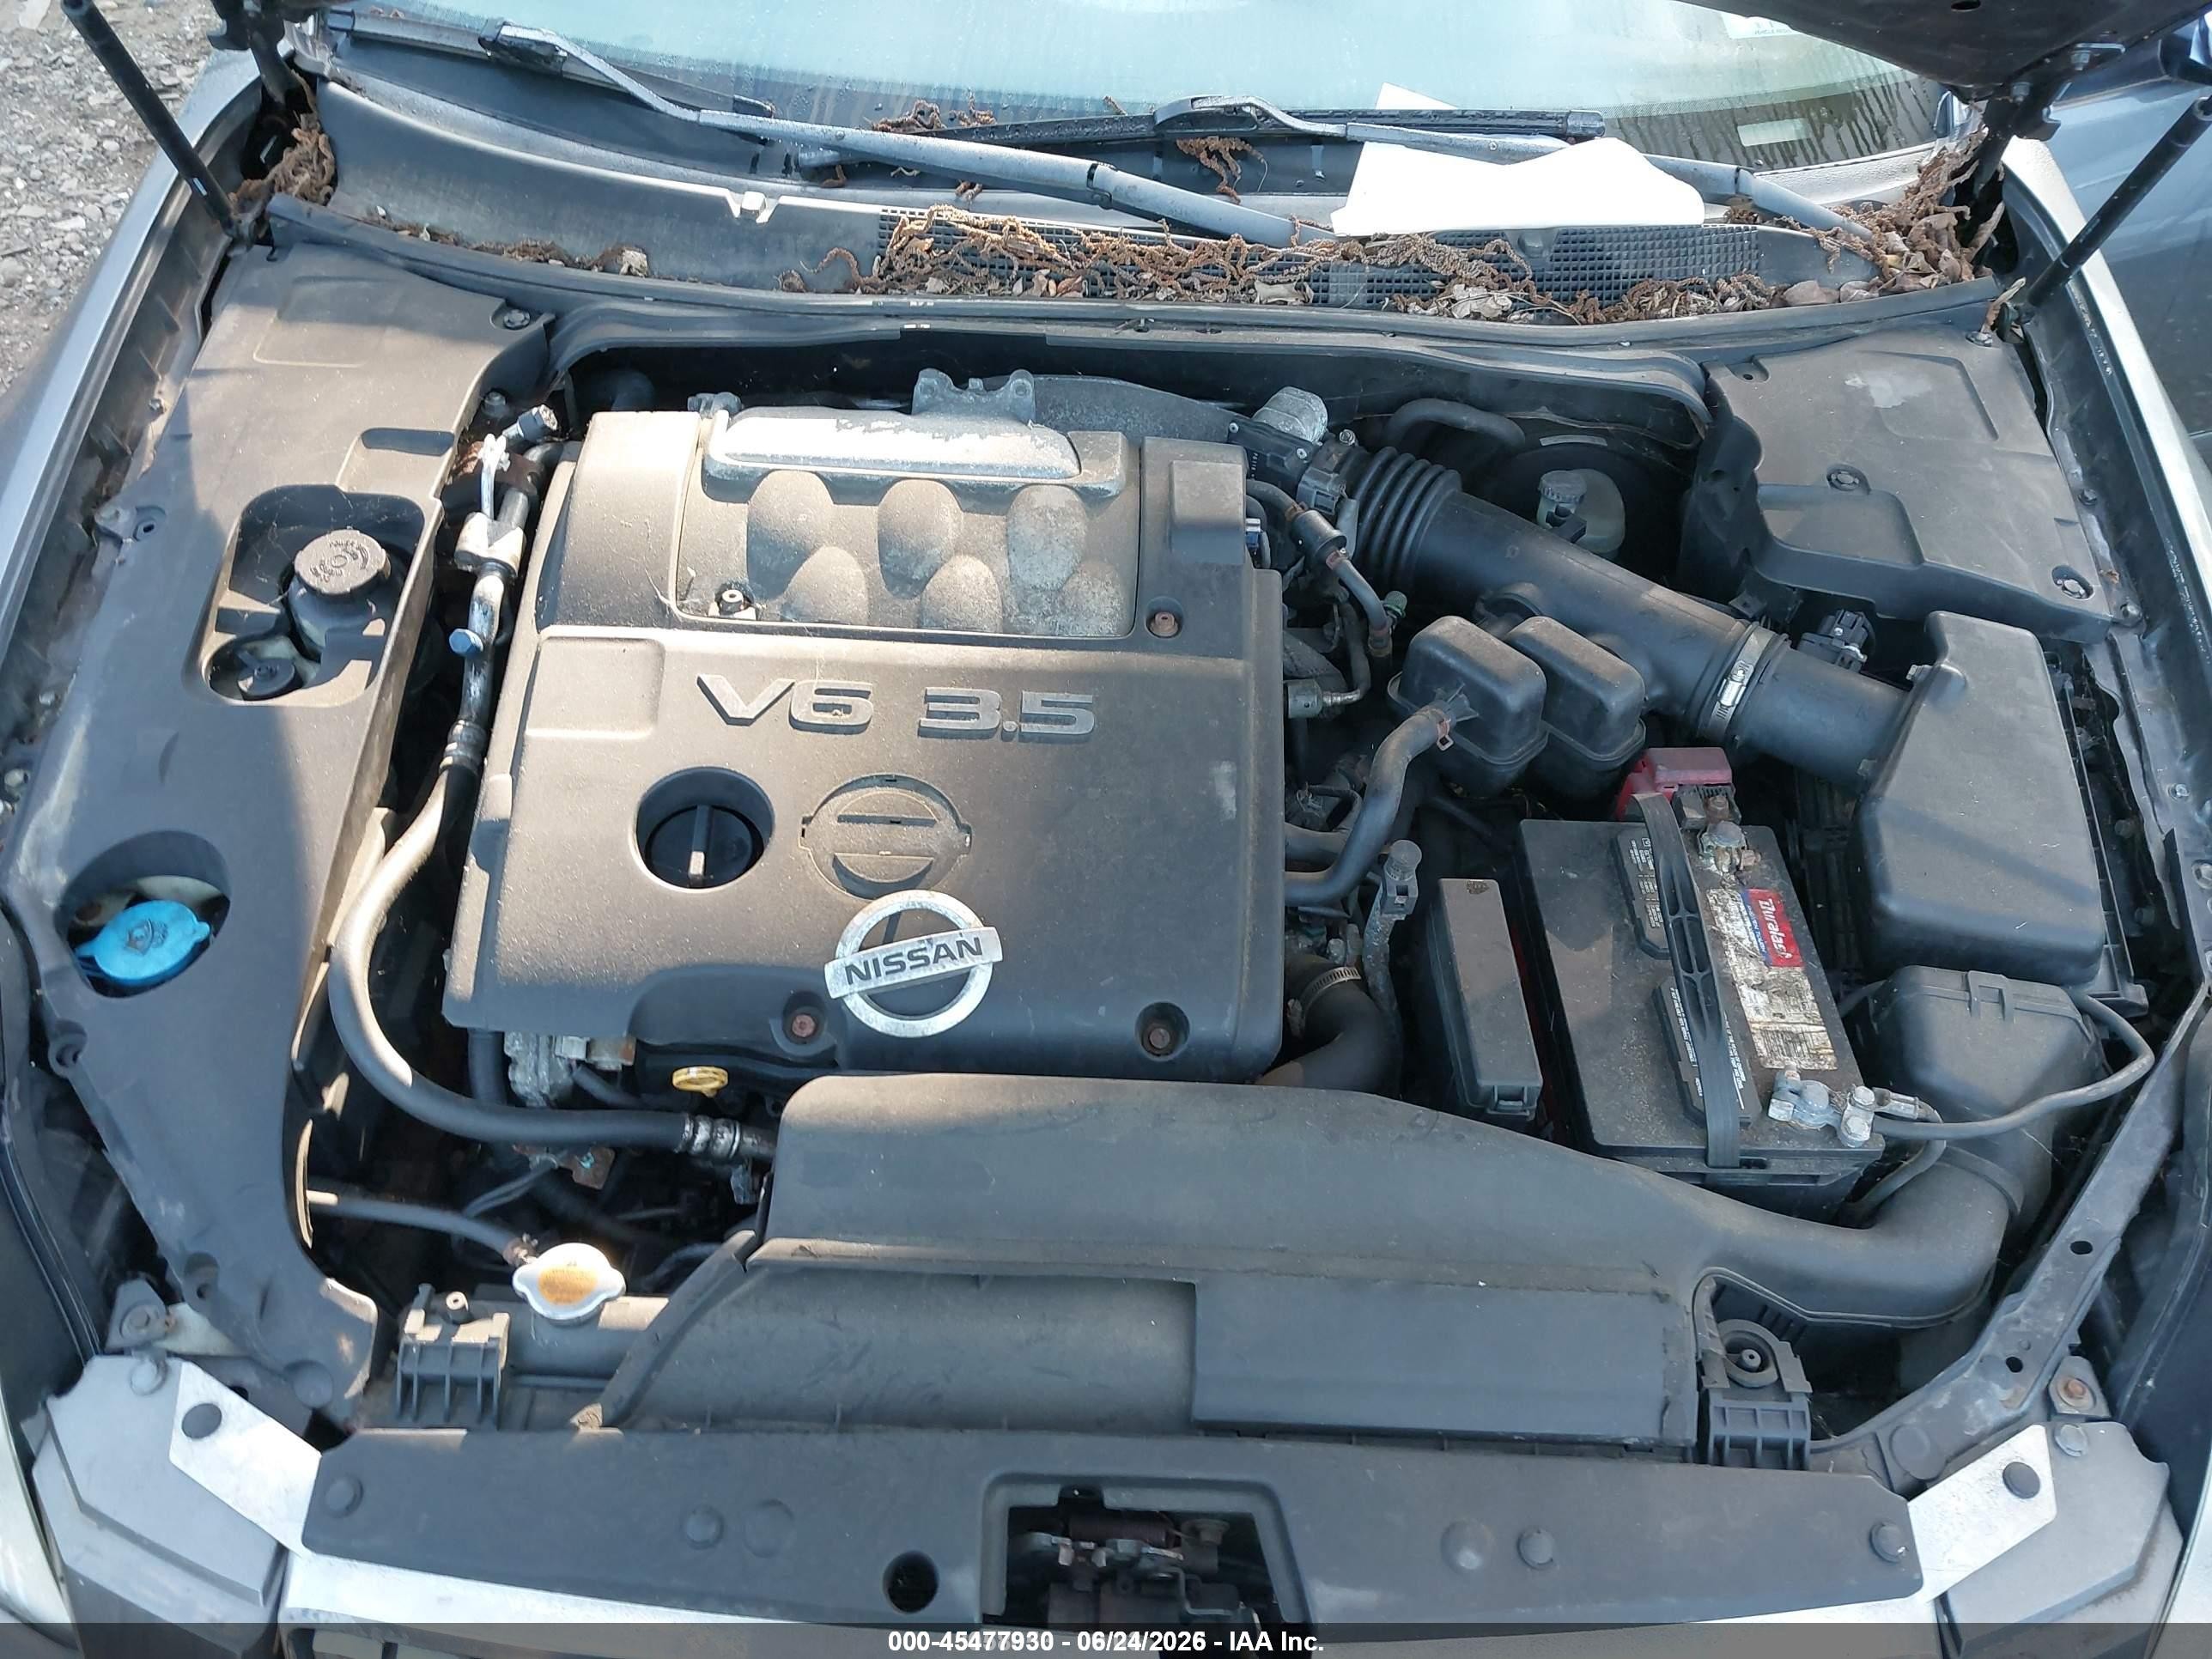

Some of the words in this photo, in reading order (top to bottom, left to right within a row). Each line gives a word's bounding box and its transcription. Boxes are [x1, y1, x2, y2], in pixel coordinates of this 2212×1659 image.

[696, 673, 874, 733] V6
[918, 686, 1096, 740] 3.5
[845, 937, 983, 986] NISSAN
